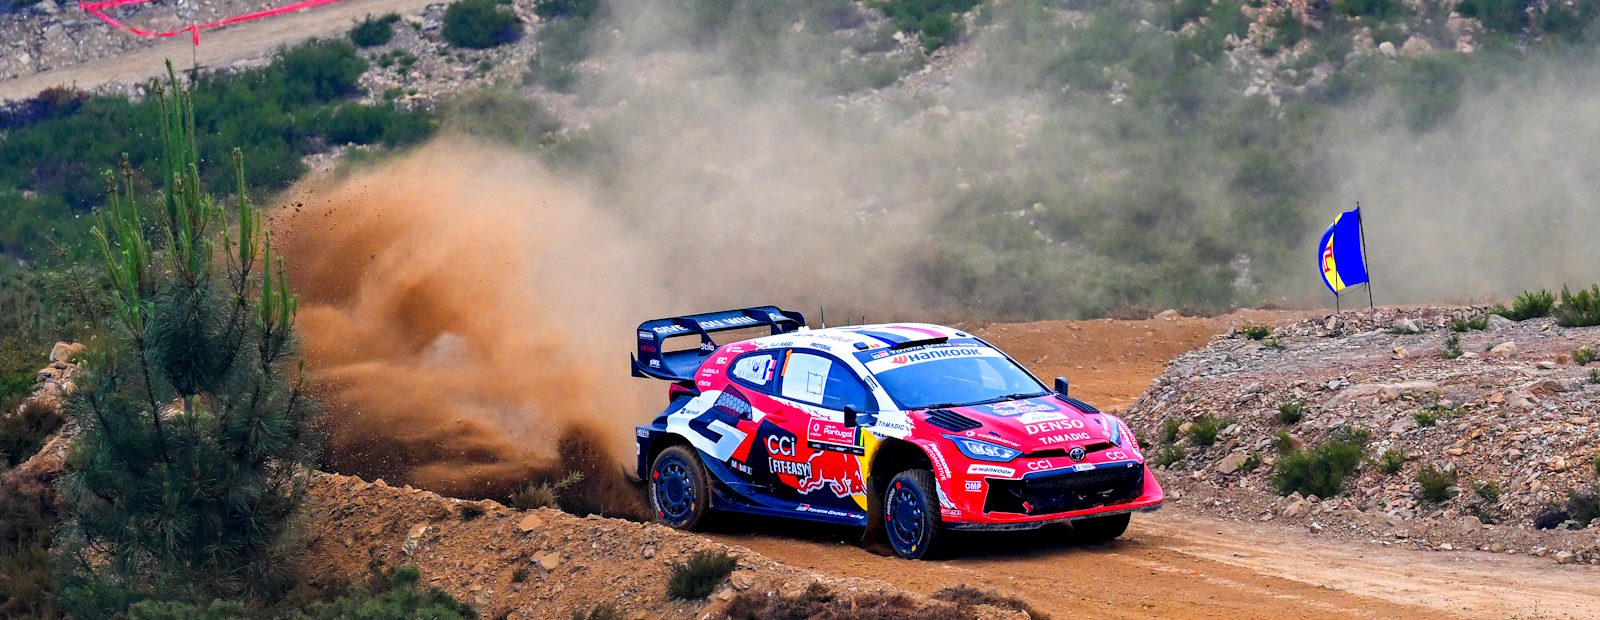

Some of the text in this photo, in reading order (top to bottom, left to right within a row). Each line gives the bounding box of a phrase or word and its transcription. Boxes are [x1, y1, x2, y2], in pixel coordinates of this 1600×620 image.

[878, 420, 905, 431] TAMADIC
[1024, 419, 1085, 435] DENSO
[823, 427, 853, 439] Portugal
[1038, 432, 1091, 445] TAMADIC
[928, 443, 952, 479] Panasonic
[1105, 451, 1129, 460] CCI
[922, 444, 947, 481] AUTOMOTIVE
[1027, 459, 1053, 471] CCI
[965, 482, 982, 491] OMP
